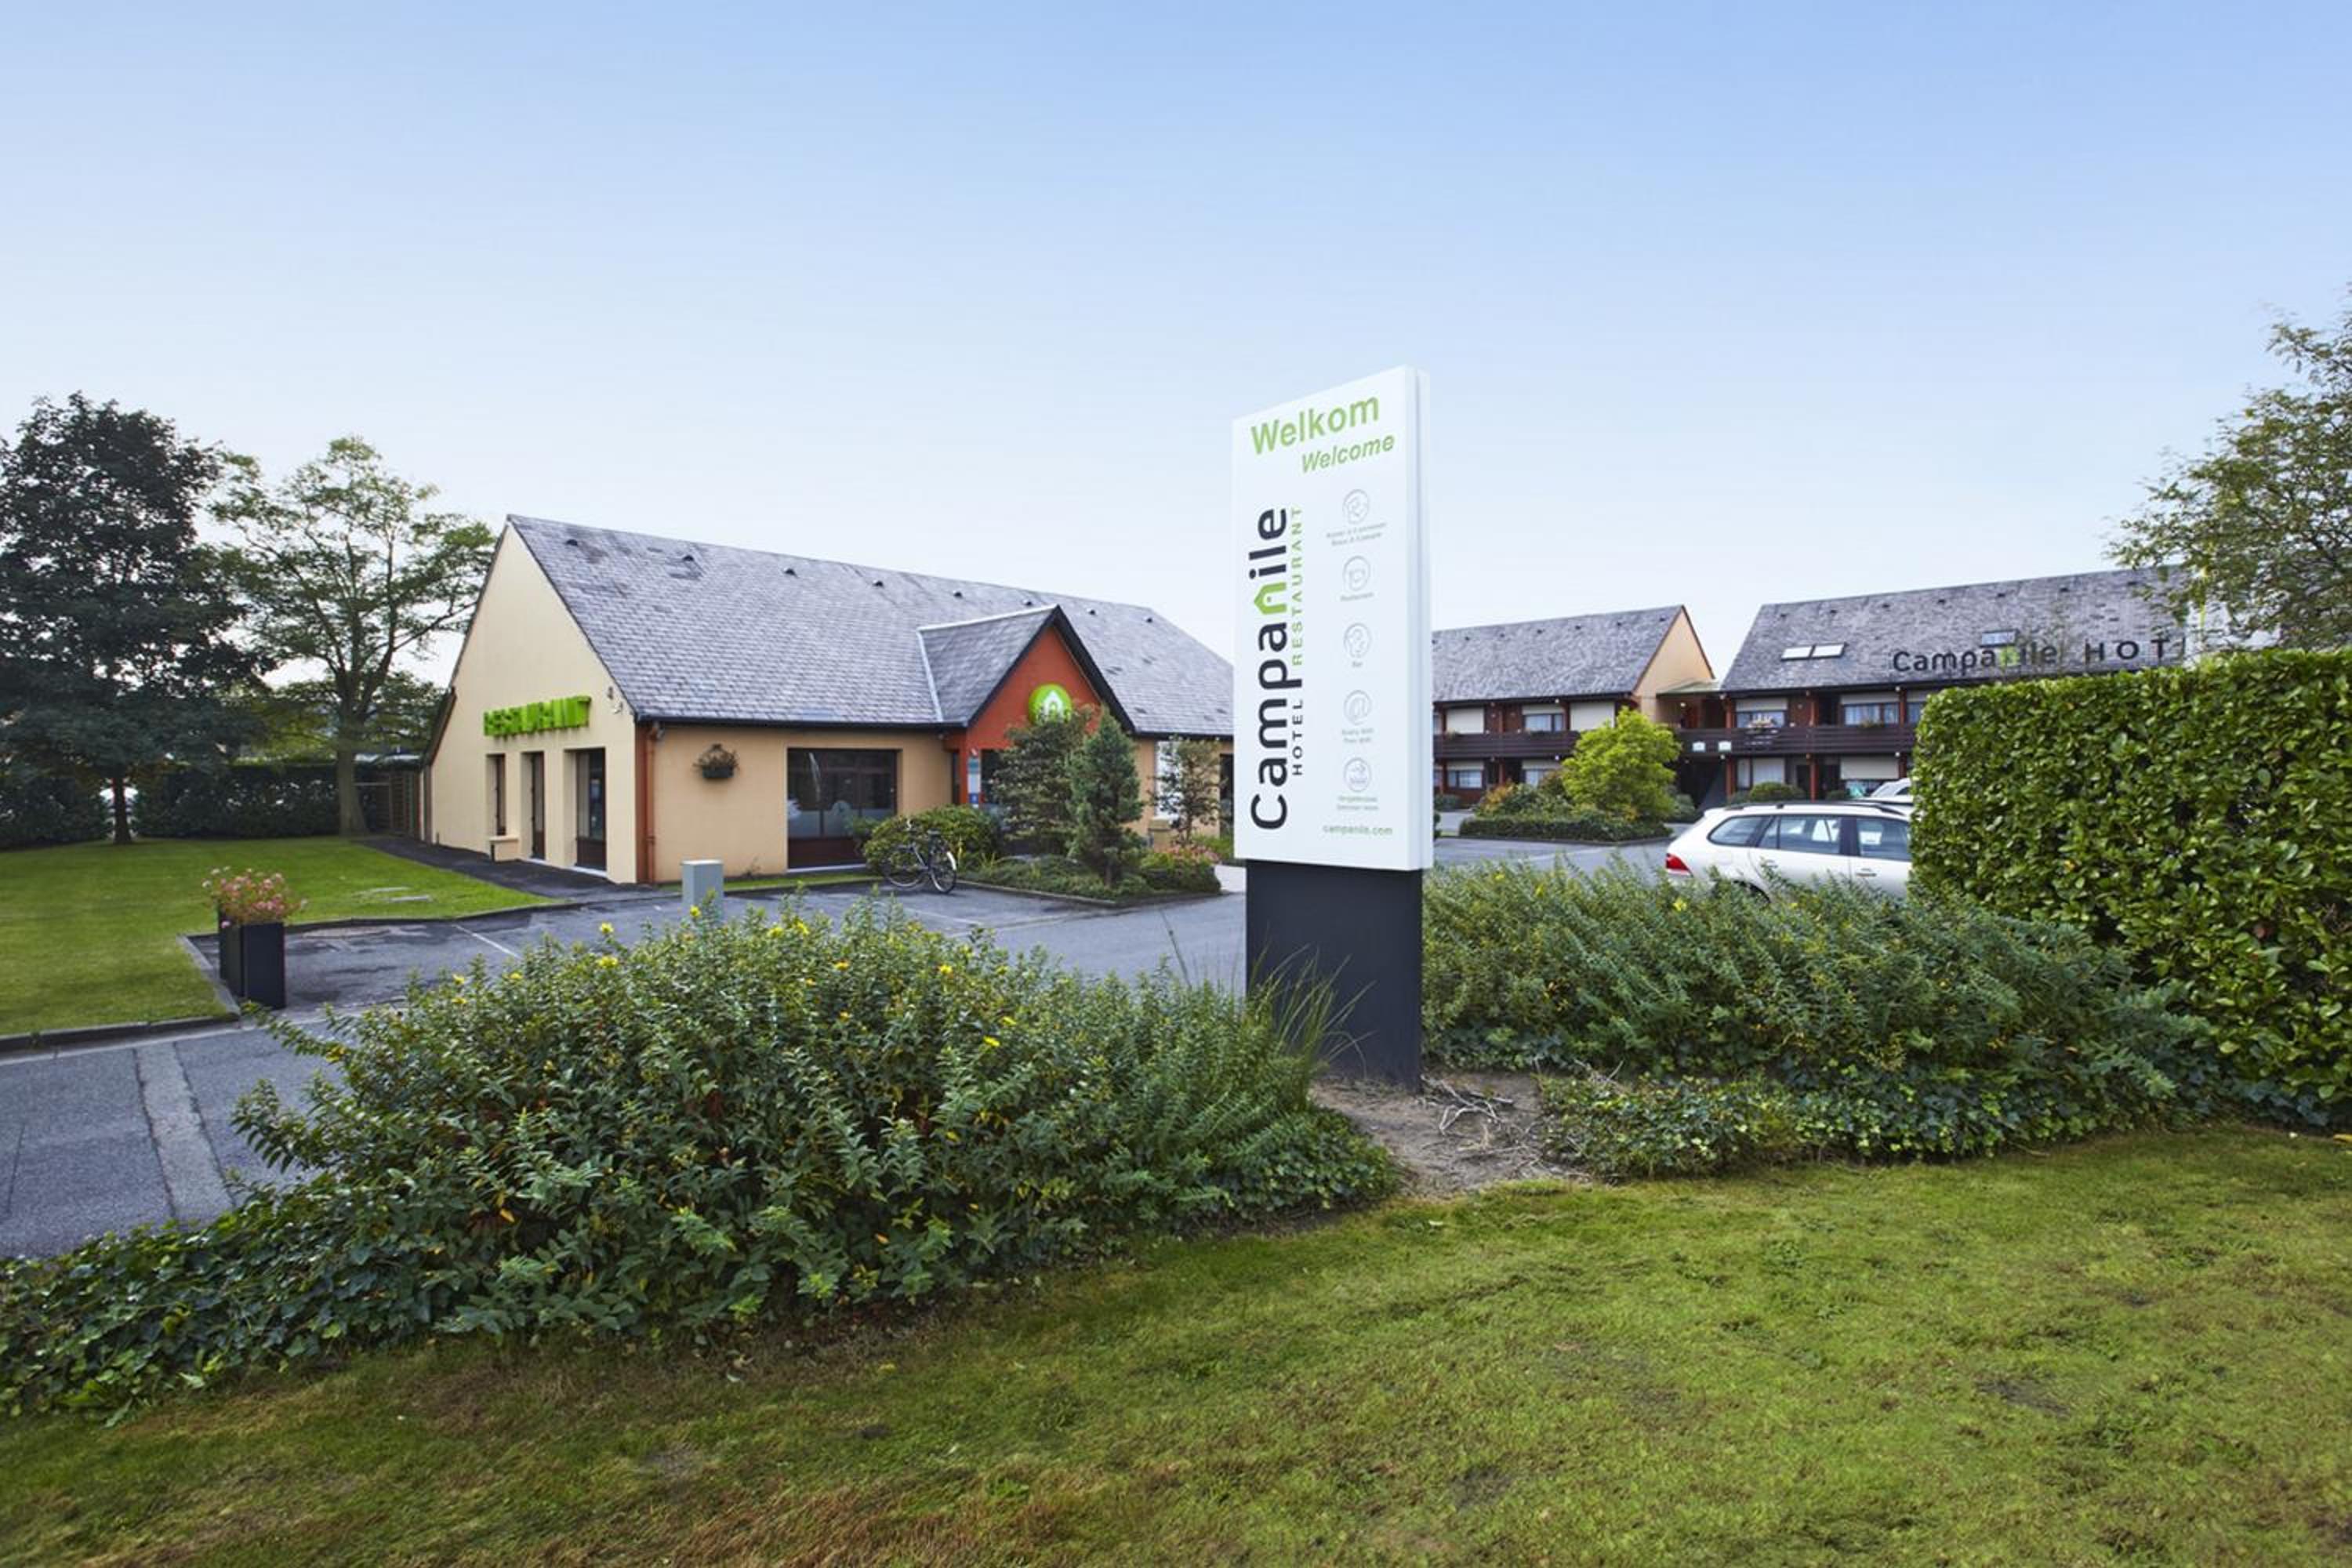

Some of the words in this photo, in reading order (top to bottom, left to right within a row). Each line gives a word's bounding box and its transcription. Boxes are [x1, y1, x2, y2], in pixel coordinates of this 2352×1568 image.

[1250, 396, 1380, 456] Welkom
[1301, 434, 1396, 474] Welcome
[1291, 507, 1303, 666] RESTAURANT
[1248, 507, 1302, 830] Campanile
[1291, 699, 1303, 775] HOTEL
